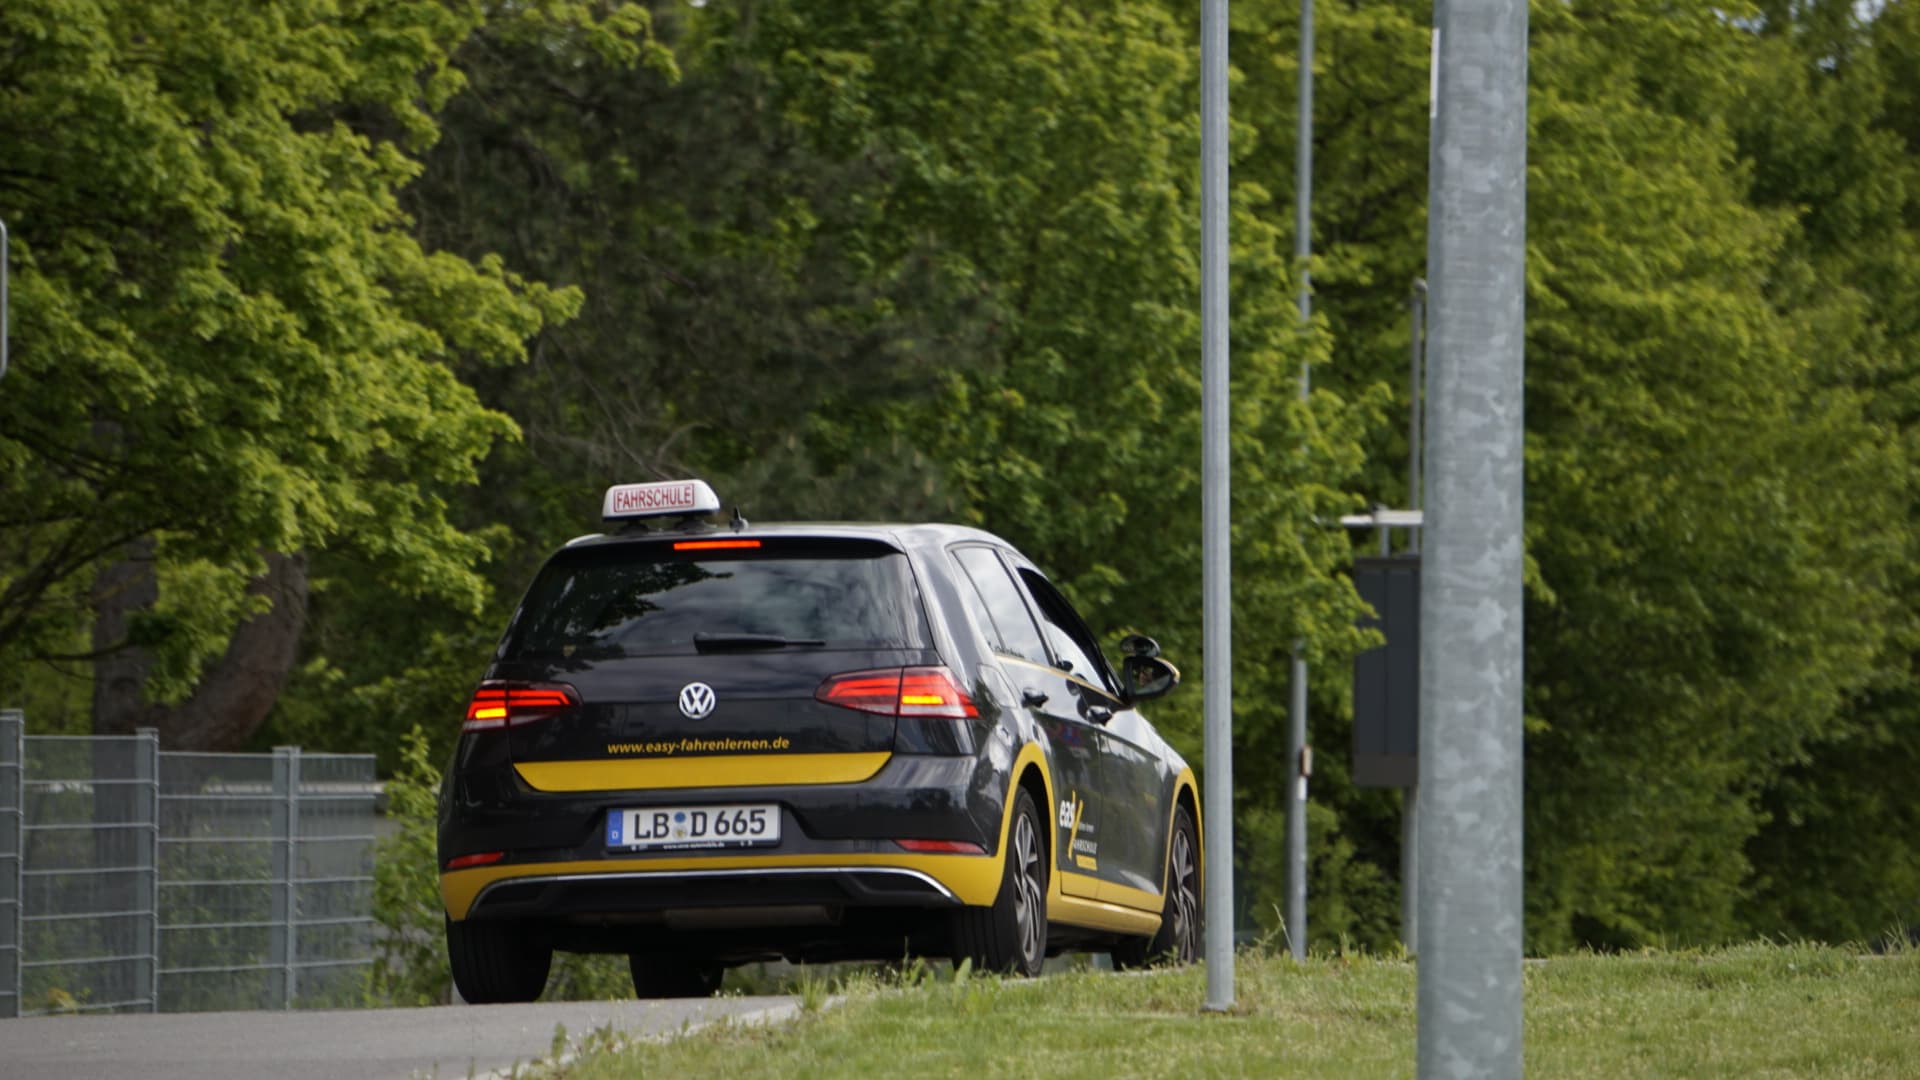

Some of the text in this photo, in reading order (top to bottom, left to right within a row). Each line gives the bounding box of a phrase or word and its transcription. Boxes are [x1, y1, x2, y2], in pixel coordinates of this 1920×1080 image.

[616, 486, 691, 509] FAHRSCHULE
[607, 736, 790, 755] www.easy-fahrenlernen.de
[633, 809, 767, 840] LB D 665
